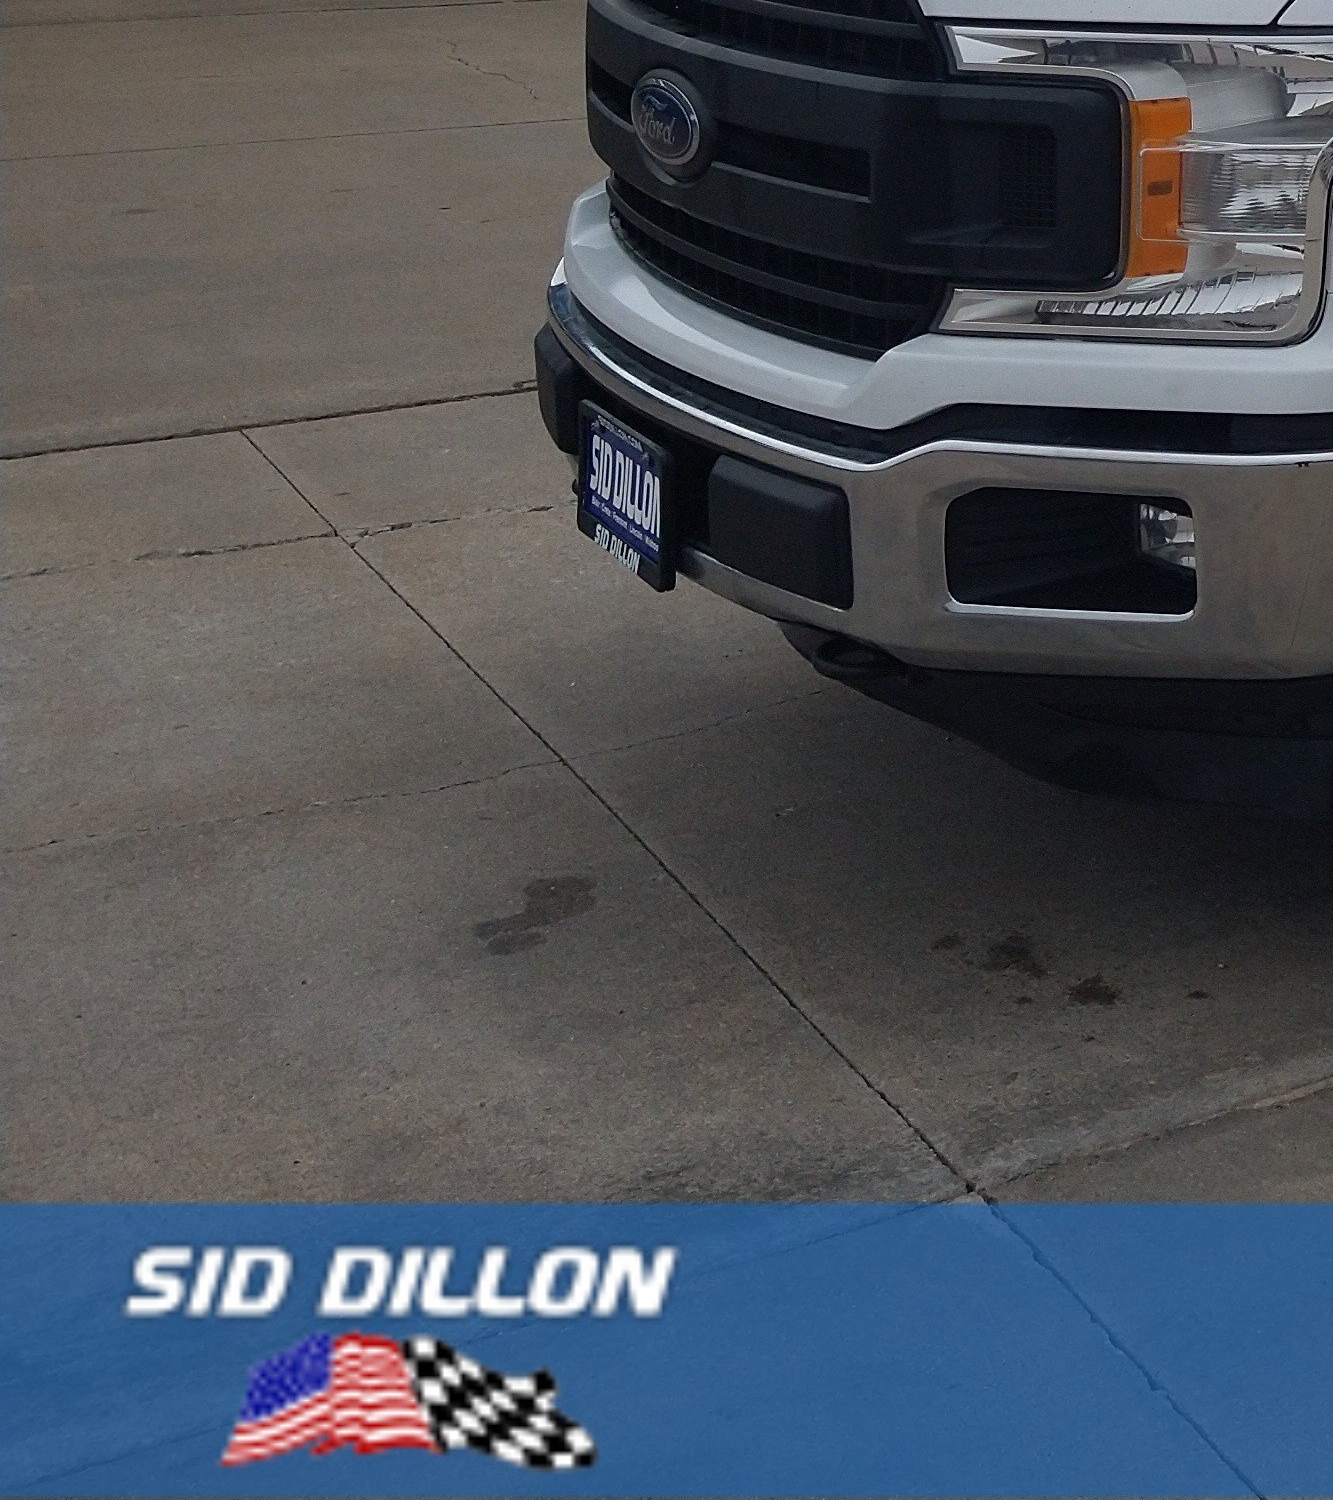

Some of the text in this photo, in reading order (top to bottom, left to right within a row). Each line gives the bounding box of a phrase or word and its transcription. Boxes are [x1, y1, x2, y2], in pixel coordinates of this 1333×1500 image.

[639, 95, 676, 145] Ford
[589, 434, 612, 500] SID
[612, 450, 661, 538] DILLON
[594, 523, 640, 574] SID DILLON
